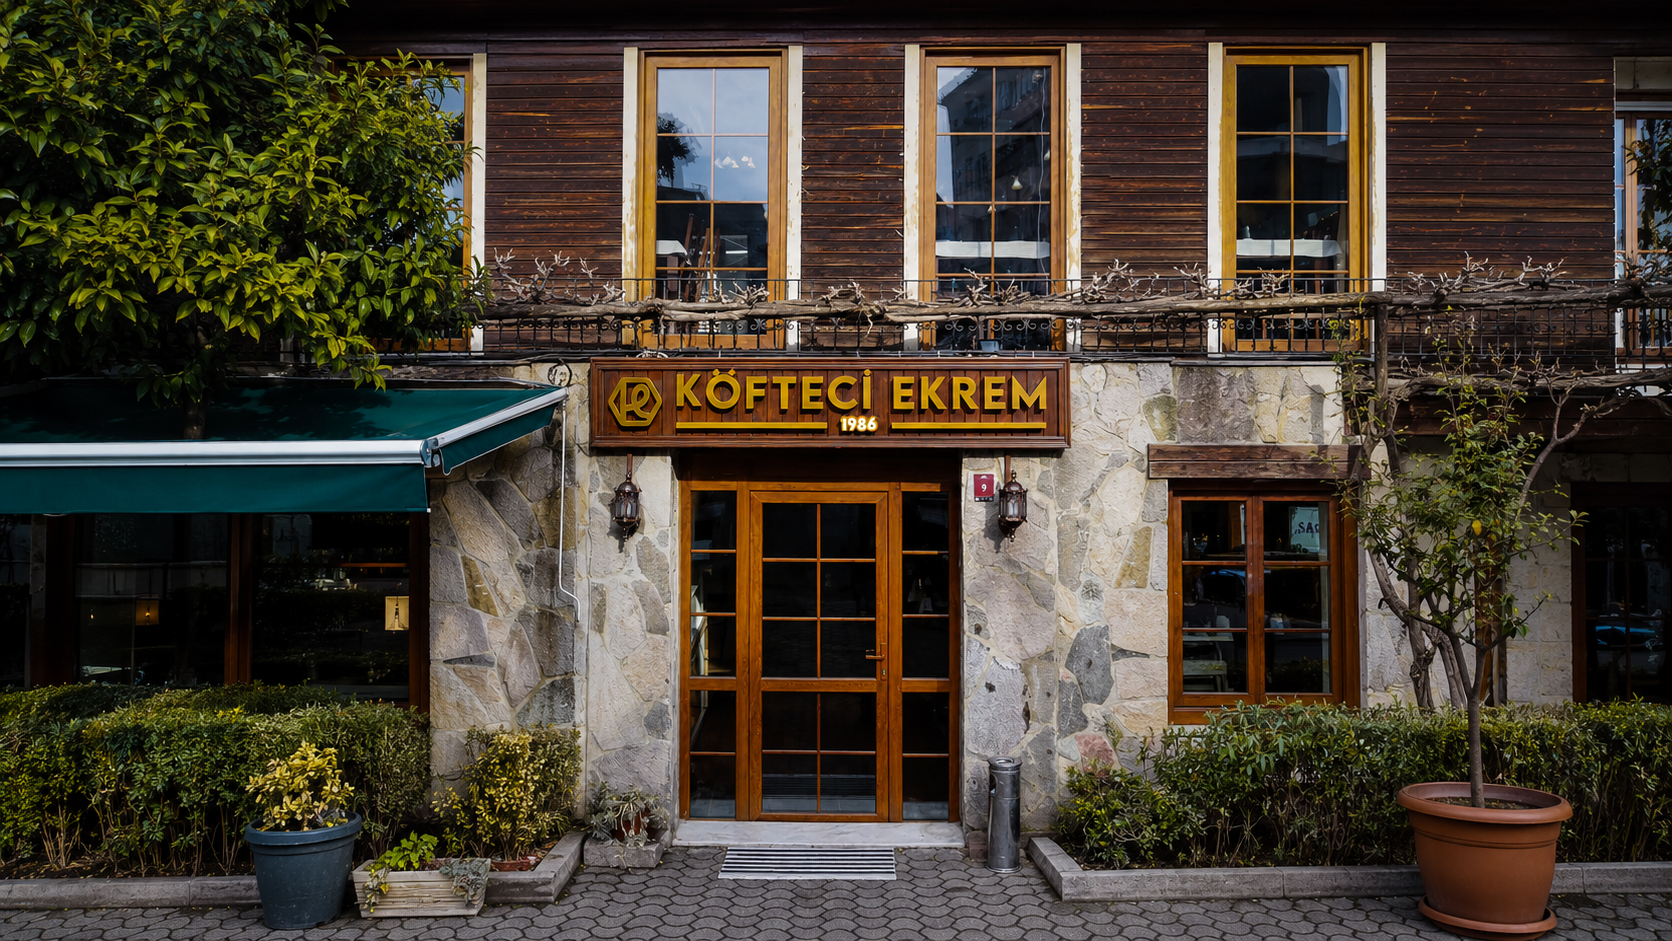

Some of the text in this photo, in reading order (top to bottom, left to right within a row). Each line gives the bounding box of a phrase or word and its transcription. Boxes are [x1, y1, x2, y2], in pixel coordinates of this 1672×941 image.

[676, 368, 1047, 410] KÖFTECİ EKREM
[840, 416, 877, 432] 1986
[981, 483, 987, 492] 9
